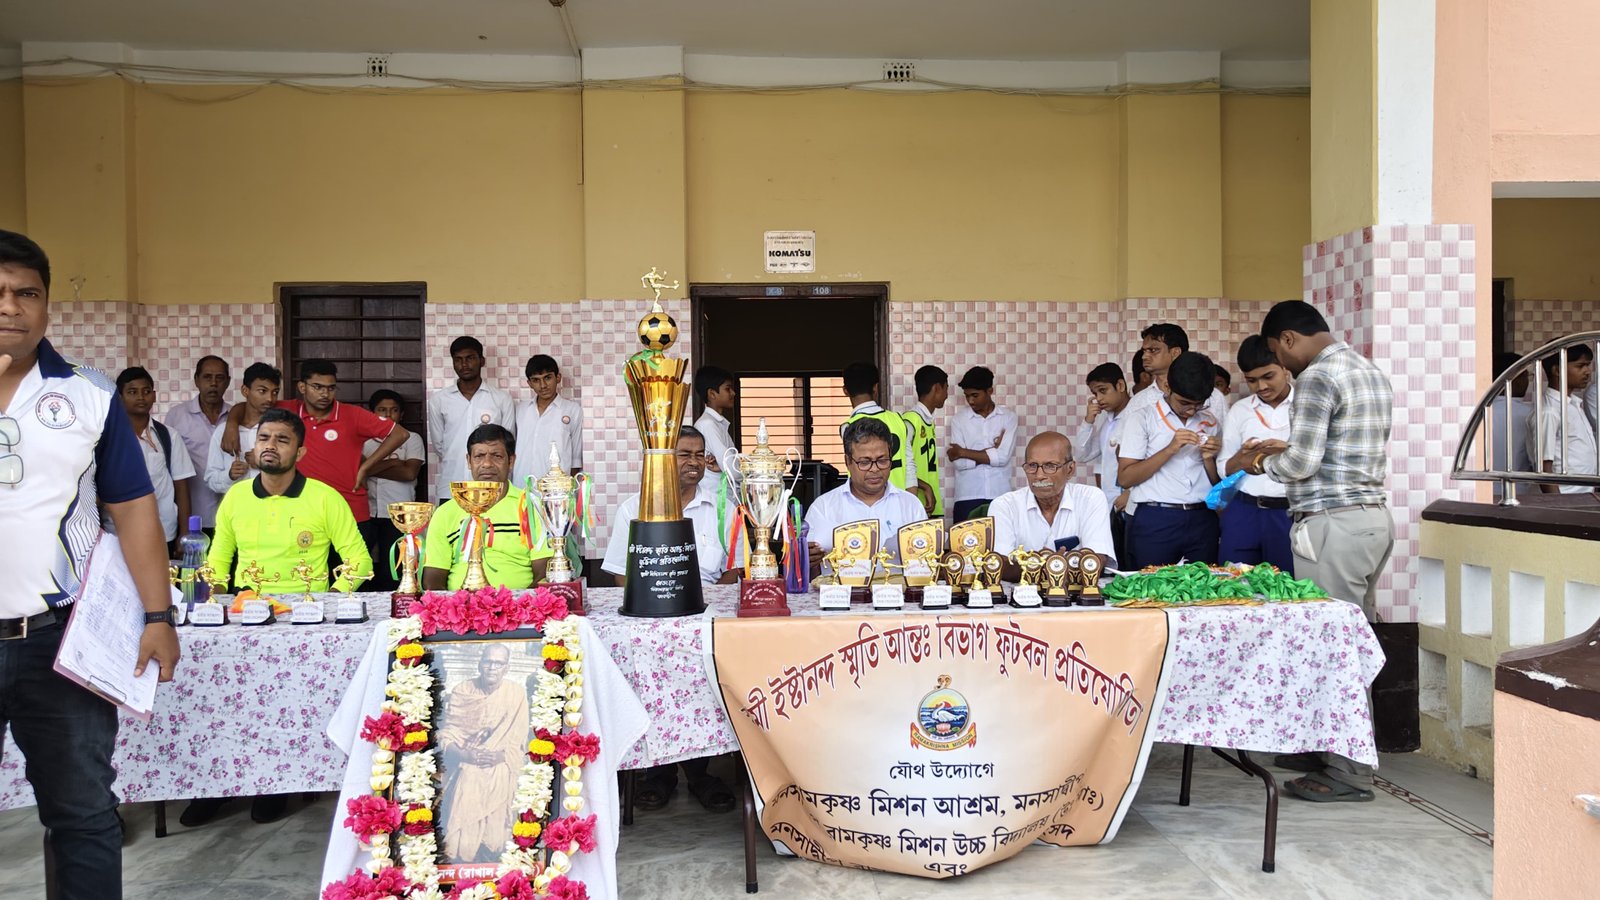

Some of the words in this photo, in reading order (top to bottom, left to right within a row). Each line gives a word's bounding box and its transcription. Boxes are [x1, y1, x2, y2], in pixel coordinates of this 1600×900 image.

[768, 248, 811, 257] KOMATSU
[813, 286, 829, 295] 108
[921, 438, 937, 472] 12
[768, 653, 834, 720] ইষ্টানন্দ
[838, 623, 880, 688] স্মৃতি
[883, 622, 930, 664] আন্তঃ
[936, 615, 989, 661] বিভাগ
[994, 616, 1050, 678] ফুটবল
[913, 732, 950, 749] RAMAKRISHNA
[952, 733, 973, 748] MISSION
[890, 762, 925, 779] যৌথ
[930, 761, 994, 779] উদ্যোগে
[868, 788, 927, 817] মিশন
[933, 794, 1006, 818] আশ্রম,
[898, 828, 947, 856] মিশন
[953, 830, 986, 856] উচ্চ
